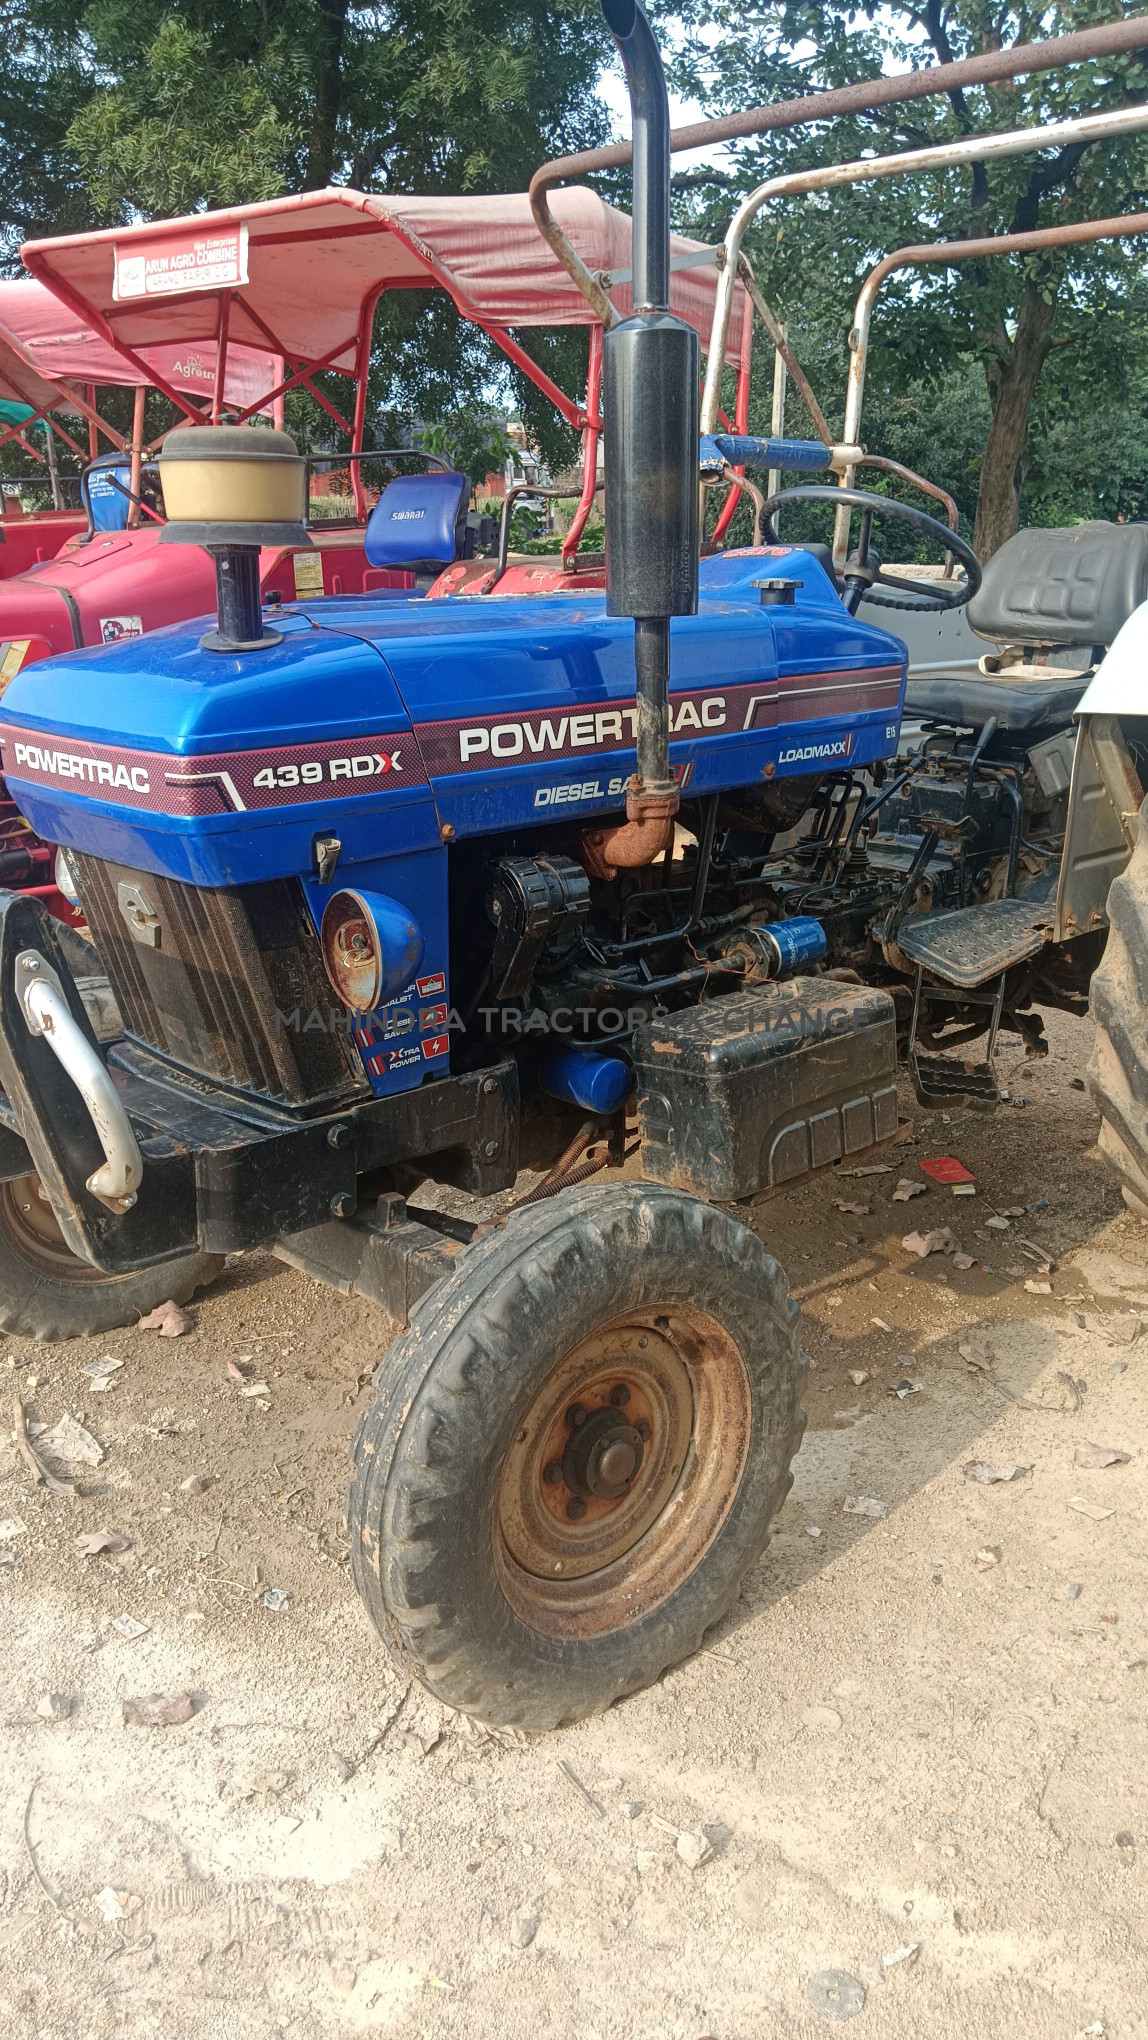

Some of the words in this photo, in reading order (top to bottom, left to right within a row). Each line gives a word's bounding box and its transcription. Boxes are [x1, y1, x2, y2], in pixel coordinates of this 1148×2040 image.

[206, 237, 238, 250] Enterprises
[145, 257, 169, 274] ARUN
[170, 253, 195, 271] AGRO
[196, 246, 238, 266] COMBINE
[458, 697, 727, 763] POWERTAC
[885, 726, 896, 739] E15
[778, 741, 846, 764] LOADMAXX
[14, 742, 151, 794] POWERTRAC
[252, 762, 323, 789] 439
[329, 751, 403, 781] RDX
[533, 781, 605, 807] DIESEL
[389, 1047, 421, 1062] XTRA
[389, 1054, 421, 1071] POWER
